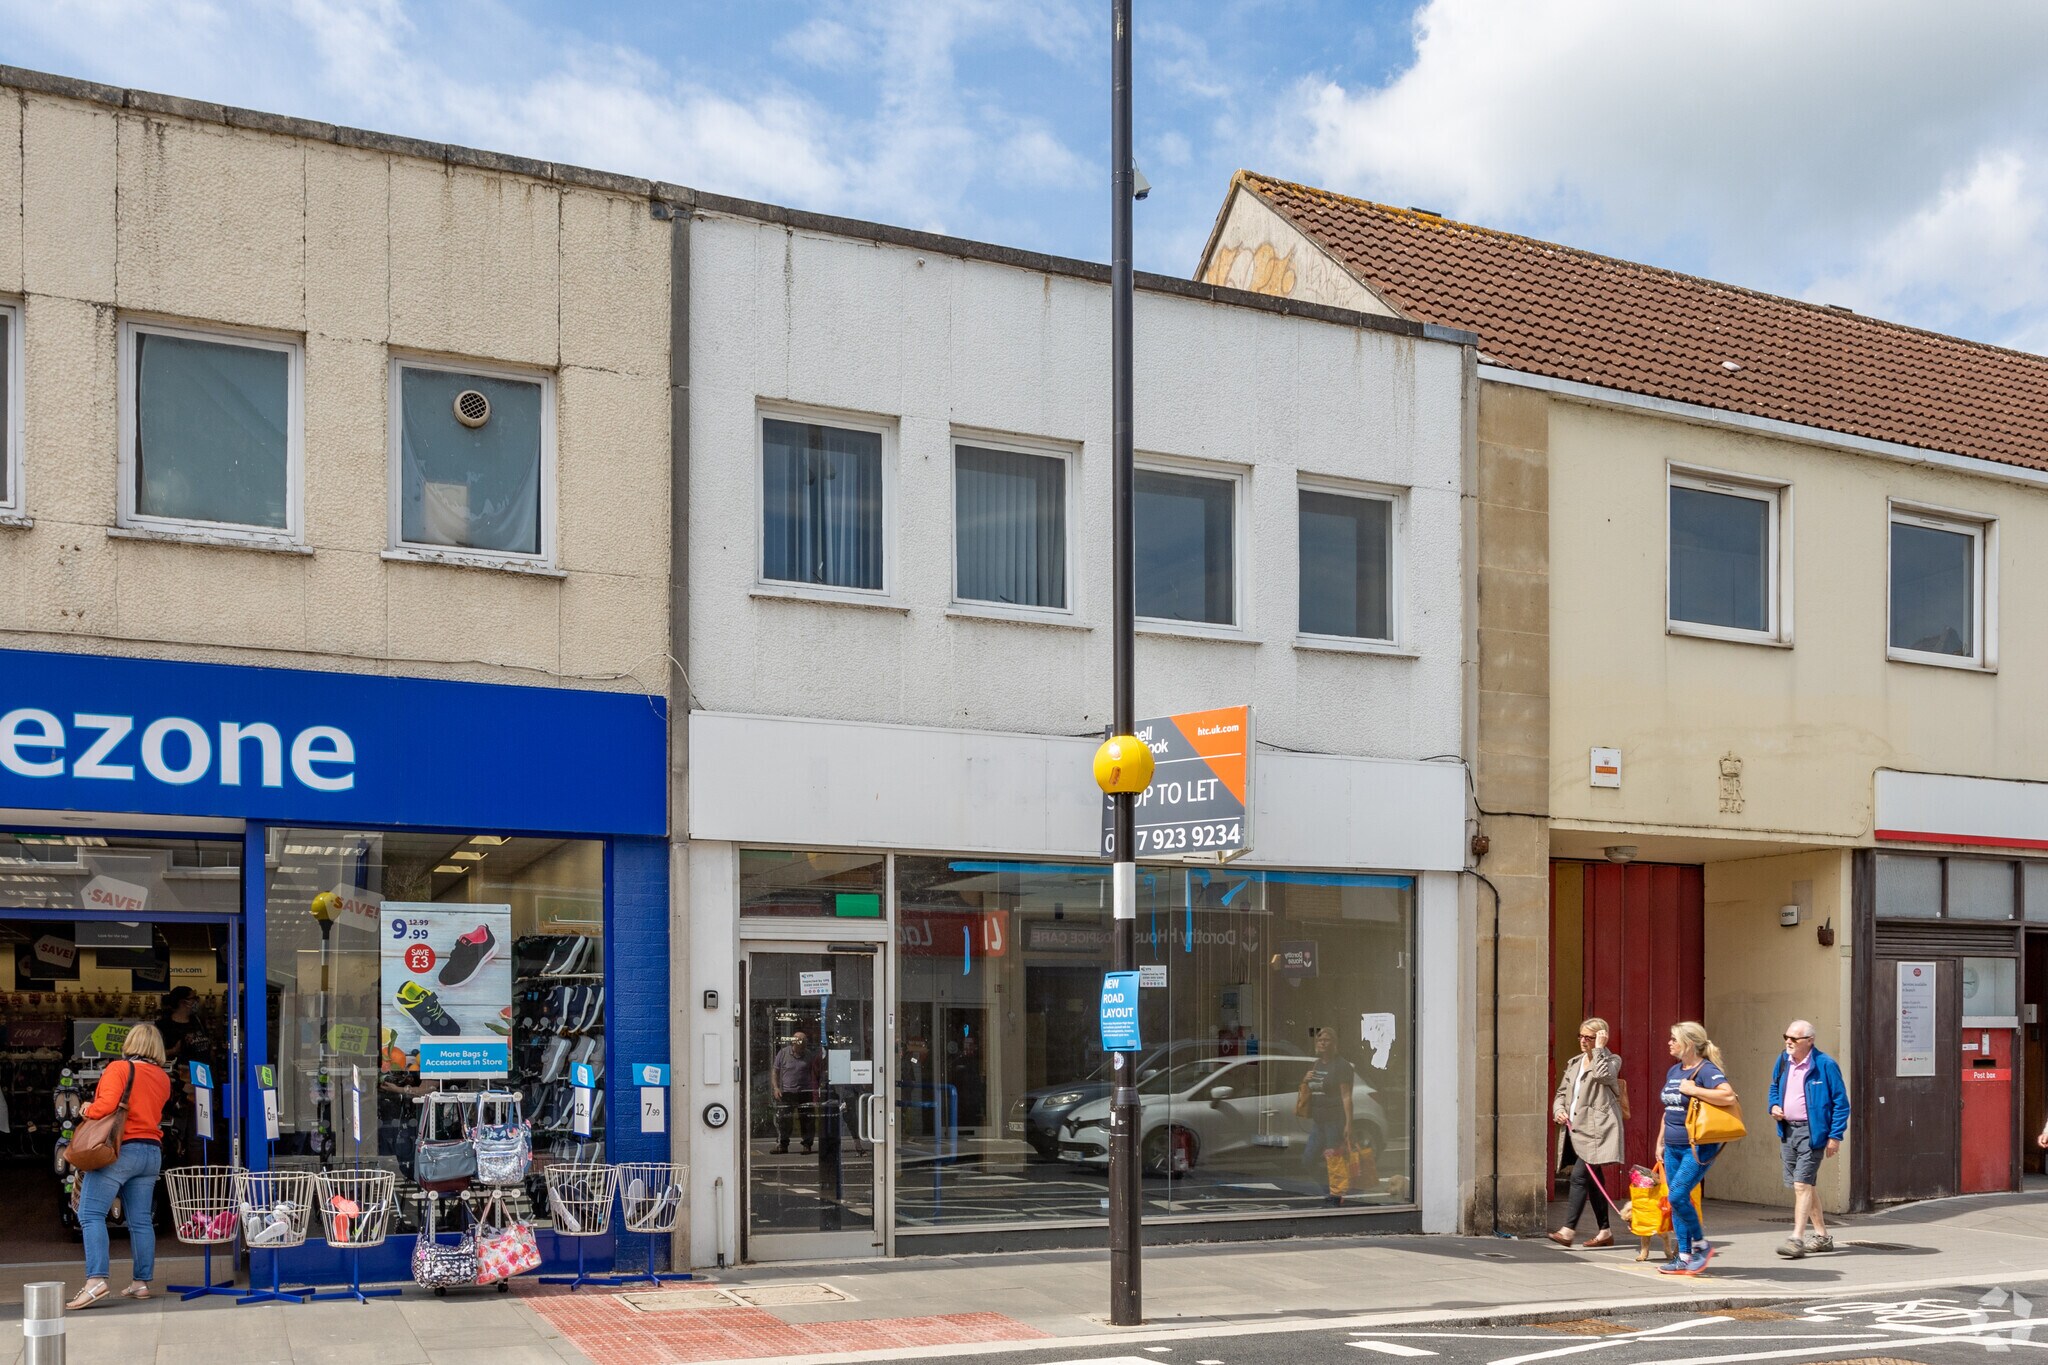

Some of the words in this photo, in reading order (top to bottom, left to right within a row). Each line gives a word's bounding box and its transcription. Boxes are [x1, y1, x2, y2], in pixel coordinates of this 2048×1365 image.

[1197, 724, 1239, 736] htc.uk.com
[0, 707, 356, 792] ezone
[1147, 739, 1169, 754] ook
[1157, 782, 1182, 805] TO
[1187, 778, 1218, 803] LET
[1105, 830, 1148, 853] 07
[1152, 828, 1187, 850] 923
[1191, 823, 1241, 848] 9234
[91, 889, 143, 911] SAVE!
[334, 896, 380, 920] SAVE!
[40, 943, 74, 960] SAVE!
[411, 948, 430, 957] SAVE
[411, 956, 430, 969] £3
[1104, 978, 1120, 990] NEW
[1102, 993, 1125, 1004] ROAD
[1102, 1007, 1134, 1018] LAYOUT
[104, 1041, 123, 1052] £1
[440, 1050, 460, 1058] More
[462, 1050, 480, 1059] Bags
[425, 1058, 471, 1066] Accessories
[482, 1058, 503, 1066] Store
[1973, 1071, 1986, 1079] Post
[1986, 1071, 1996, 1079] box
